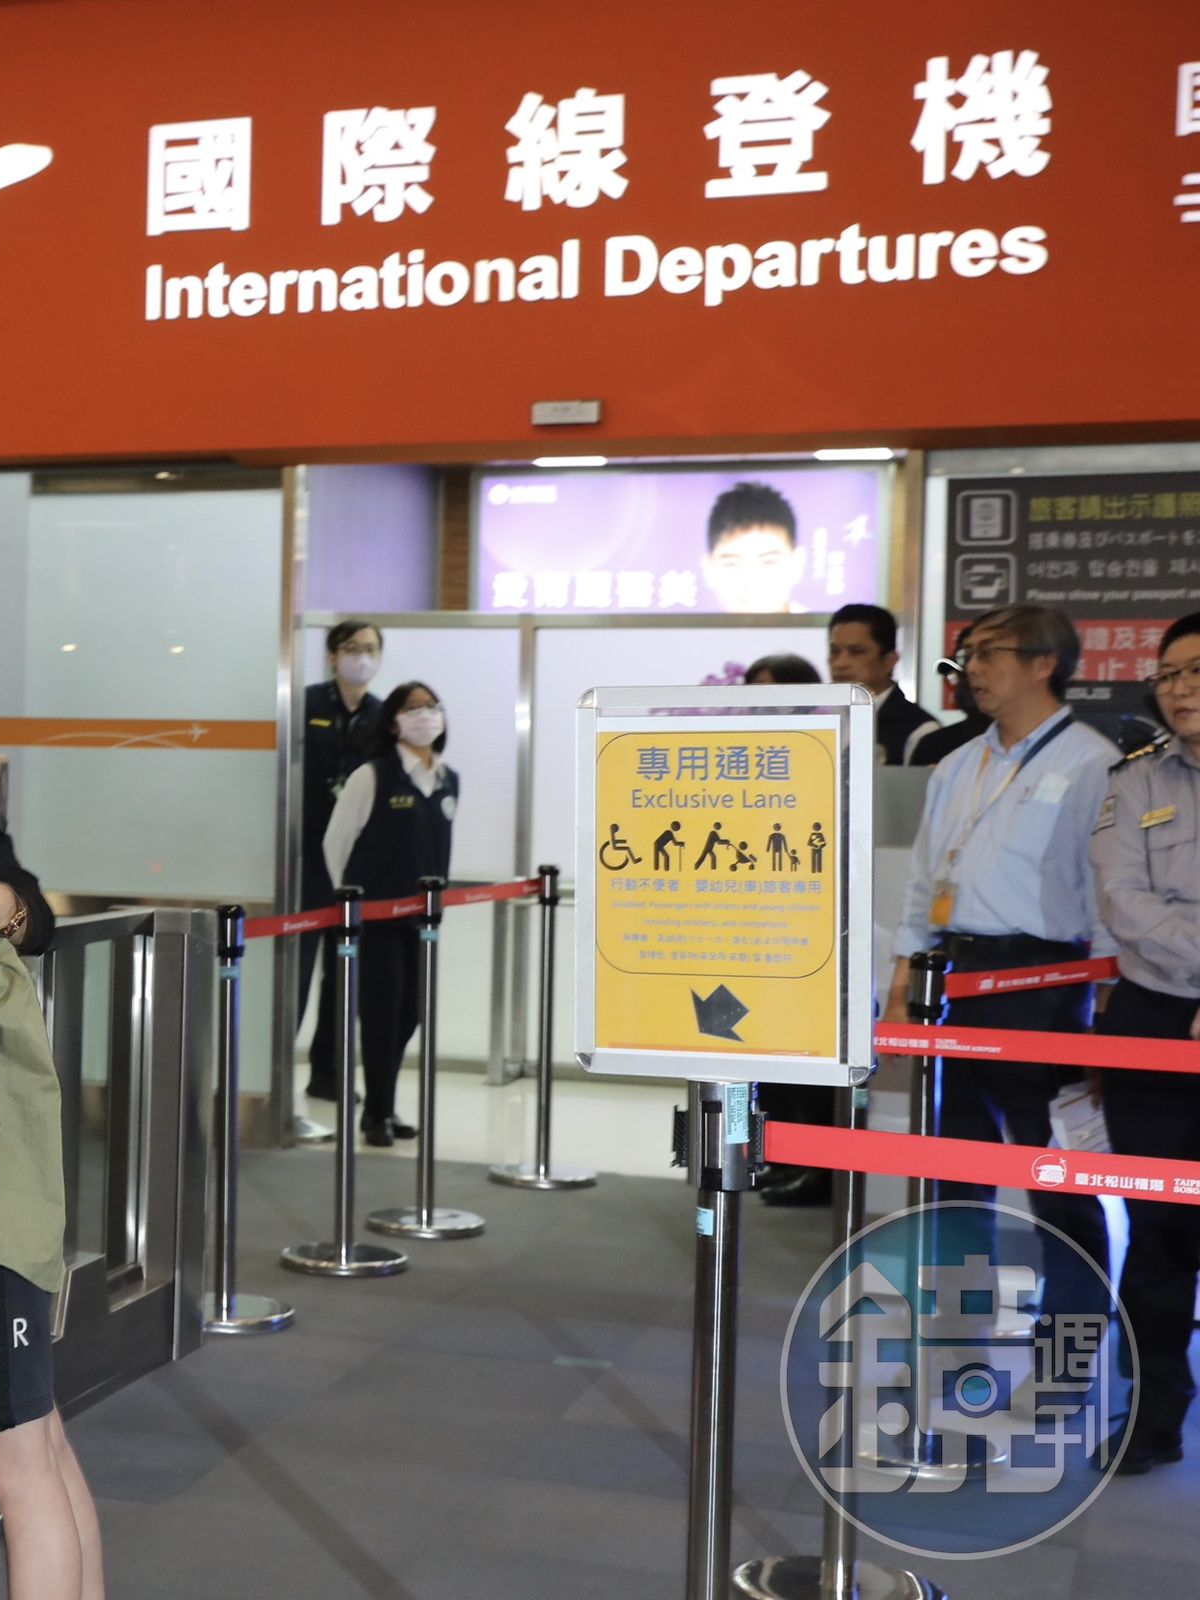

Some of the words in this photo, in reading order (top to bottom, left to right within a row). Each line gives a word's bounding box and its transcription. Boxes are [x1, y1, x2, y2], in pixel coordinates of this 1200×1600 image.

[147, 51, 1051, 237] 國際線登機
[146, 239, 579, 320] International
[605, 224, 1047, 306] Departures
[636, 745, 792, 782] 專用通道
[631, 788, 734, 809] Exclusive
[742, 789, 797, 809] Lane
[12, 1318, 29, 1348] R
